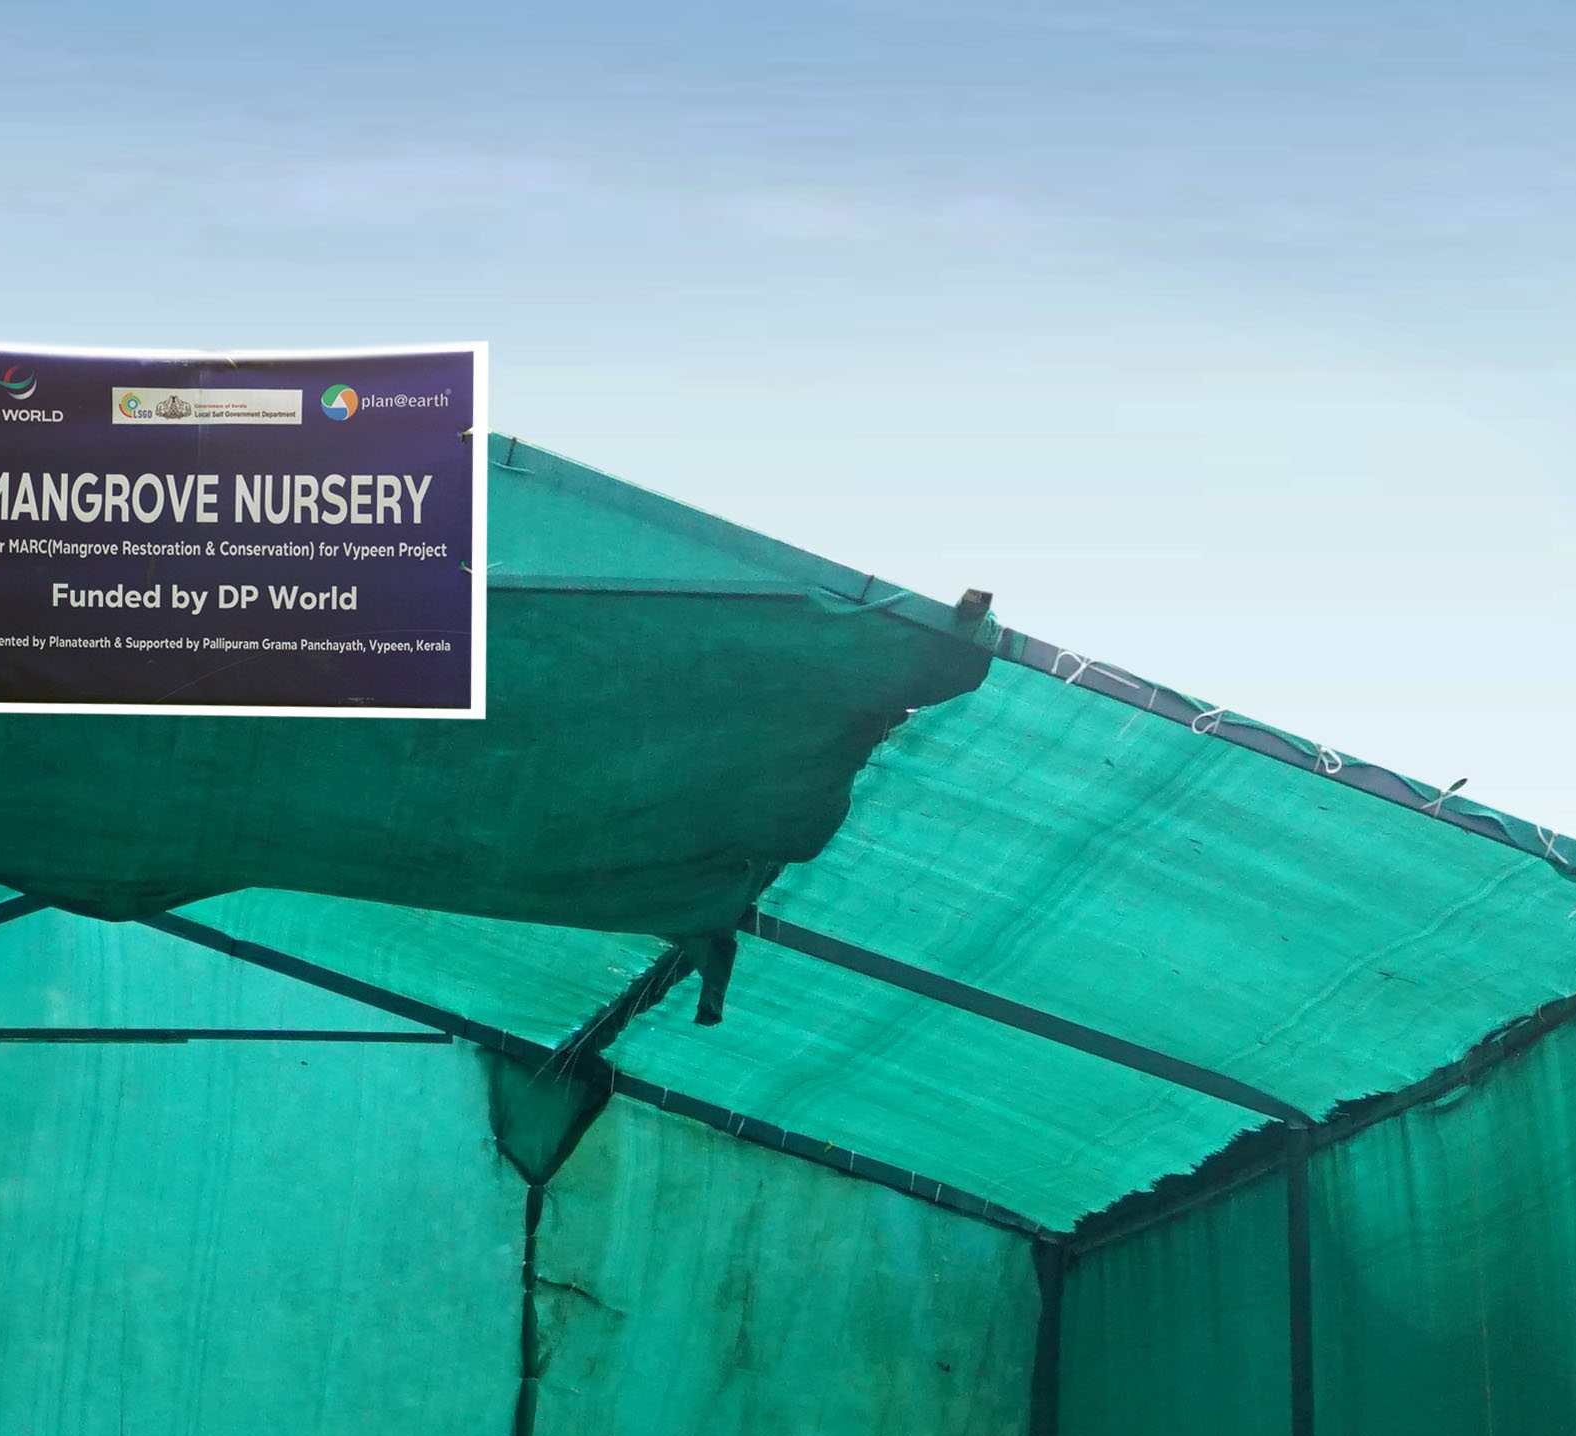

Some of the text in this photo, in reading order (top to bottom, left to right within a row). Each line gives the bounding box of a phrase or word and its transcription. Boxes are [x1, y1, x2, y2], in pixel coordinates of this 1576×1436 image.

[2, 409, 63, 423] WORLD
[235, 473, 433, 525] NURSERY
[9, 539, 118, 558] MARC(Mangrove
[122, 541, 201, 556] Restoration
[205, 541, 215, 555] &
[220, 541, 314, 560] Conservation)
[319, 543, 339, 557] for
[343, 543, 394, 560] Vypeen
[399, 543, 447, 560] Project
[52, 583, 357, 616] Funded by DP World
[32, 636, 46, 650] by
[49, 637, 111, 648] Planatearth
[114, 637, 122, 648] &
[125, 637, 183, 651] Supported
[186, 638, 199, 651] by
[203, 638, 259, 651] Pallipuram
[262, 639, 297, 650] Grama
[301, 639, 366, 653] Panchayath,
[369, 640, 413, 654] Vypeen,
[416, 640, 451, 651] Kerala
